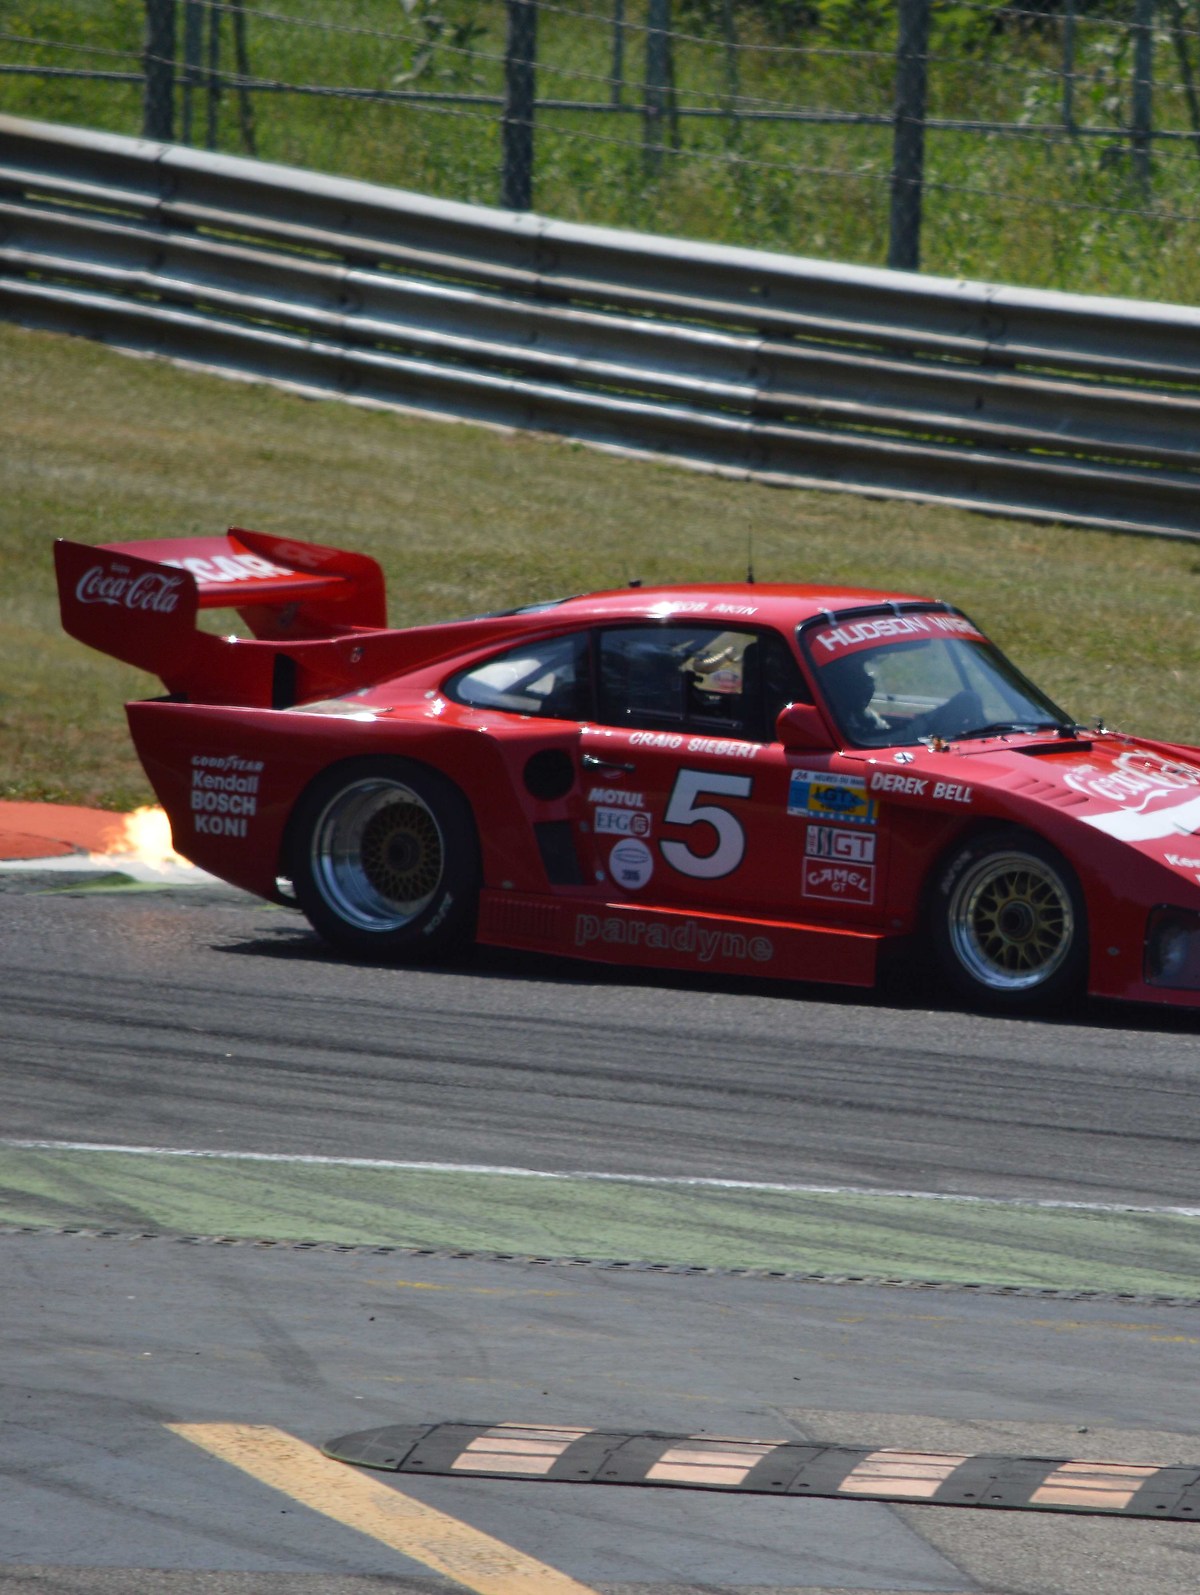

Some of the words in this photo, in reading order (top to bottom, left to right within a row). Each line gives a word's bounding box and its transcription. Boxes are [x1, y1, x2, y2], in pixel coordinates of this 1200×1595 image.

[76, 566, 184, 613] Coca-Cola
[815, 616, 930, 652] HUDSON
[629, 732, 683, 749] CRAIG
[687, 737, 763, 758] SIEBERT
[191, 755, 265, 773] GOODYEAR
[192, 769, 259, 794] Kendall
[870, 772, 929, 796] DEREK
[932, 782, 975, 803] BELL
[191, 789, 257, 817] BOSCH
[588, 788, 645, 807] MOTUL
[194, 813, 248, 838] KONI
[597, 812, 628, 831] EFG
[659, 768, 753, 879] 5
[834, 833, 873, 858] GT
[807, 868, 870, 893] CAMEL
[831, 882, 847, 893] GT
[574, 912, 775, 963] paradyne
